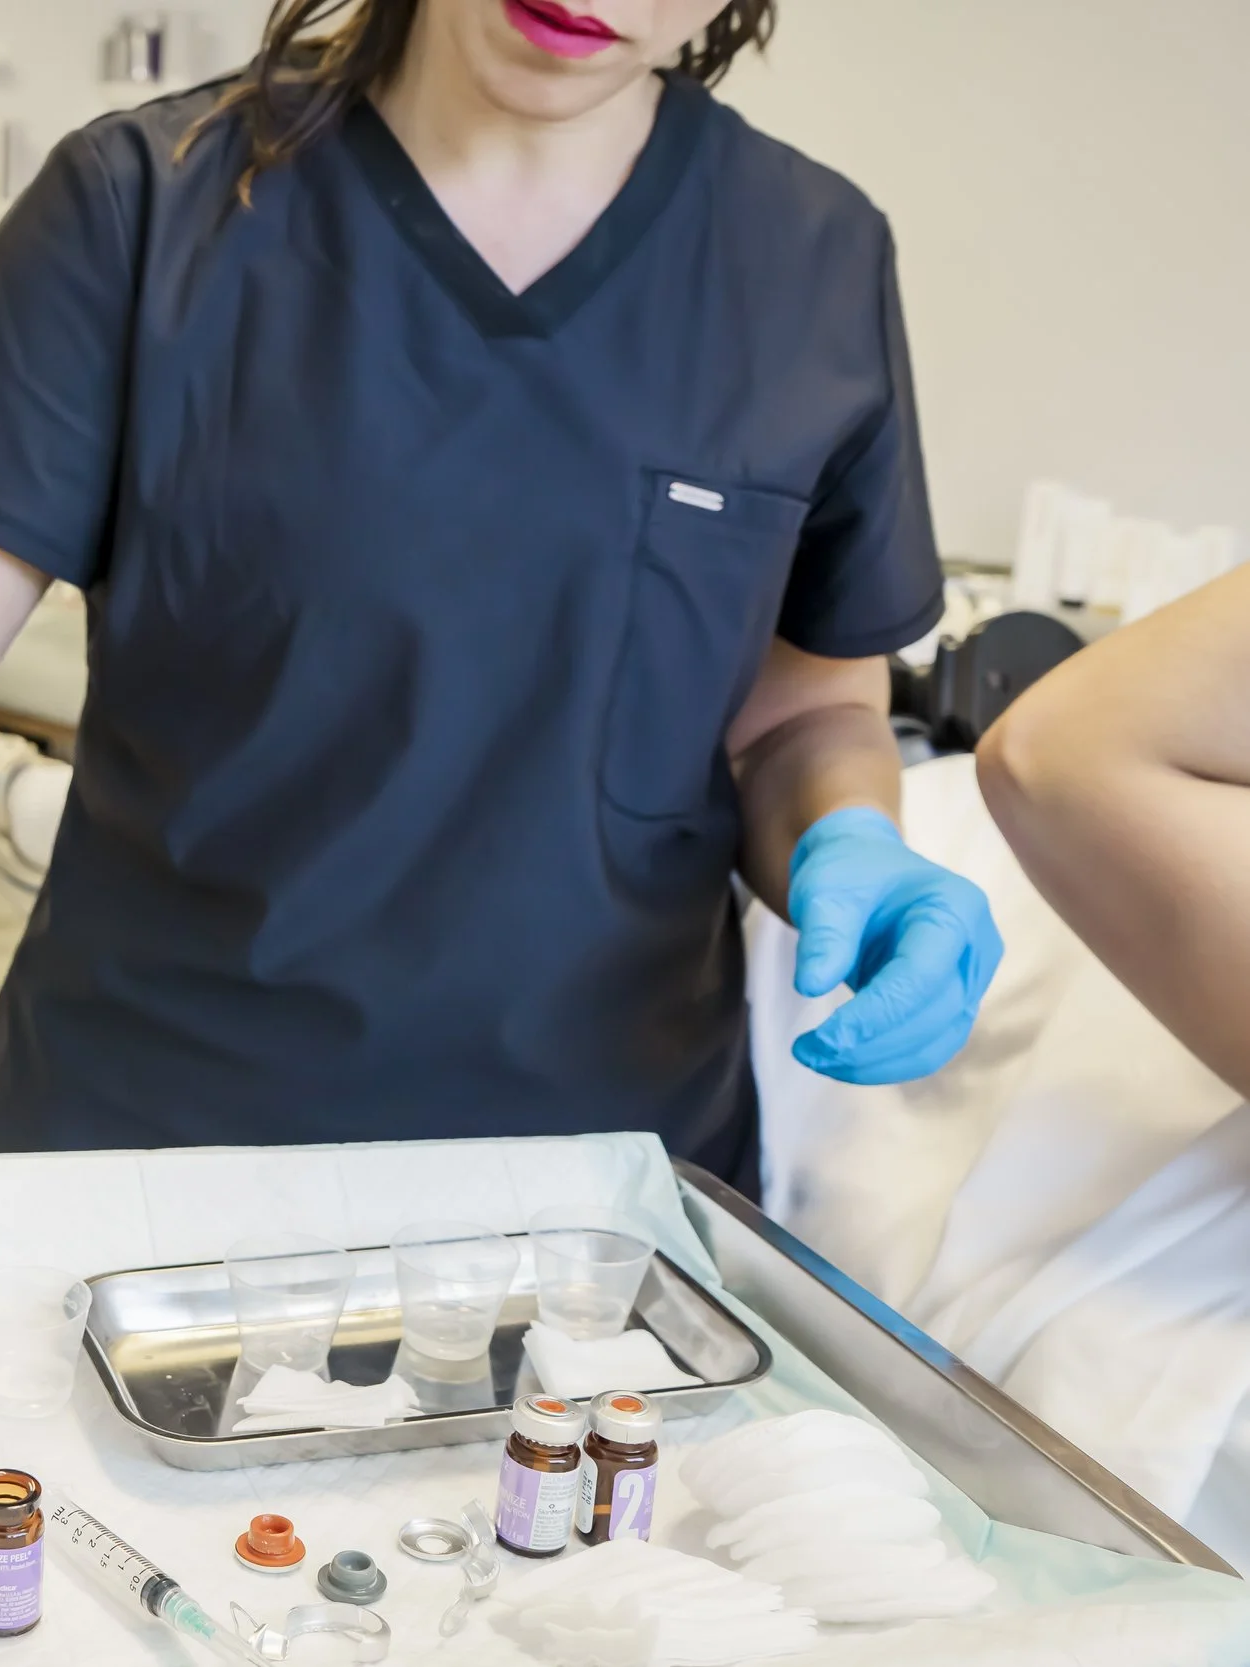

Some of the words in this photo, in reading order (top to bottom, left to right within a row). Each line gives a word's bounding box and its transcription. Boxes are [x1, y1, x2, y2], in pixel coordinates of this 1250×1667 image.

[51, 1506, 65, 1521] mL
[613, 1473, 645, 1540] 2
[60, 1516, 69, 1526] 3
[71, 1527, 83, 1545] 2.5
[88, 1538, 97, 1549] 2
[99, 1552, 111, 1569] 1.5
[129, 1575, 141, 1593] 0.5
